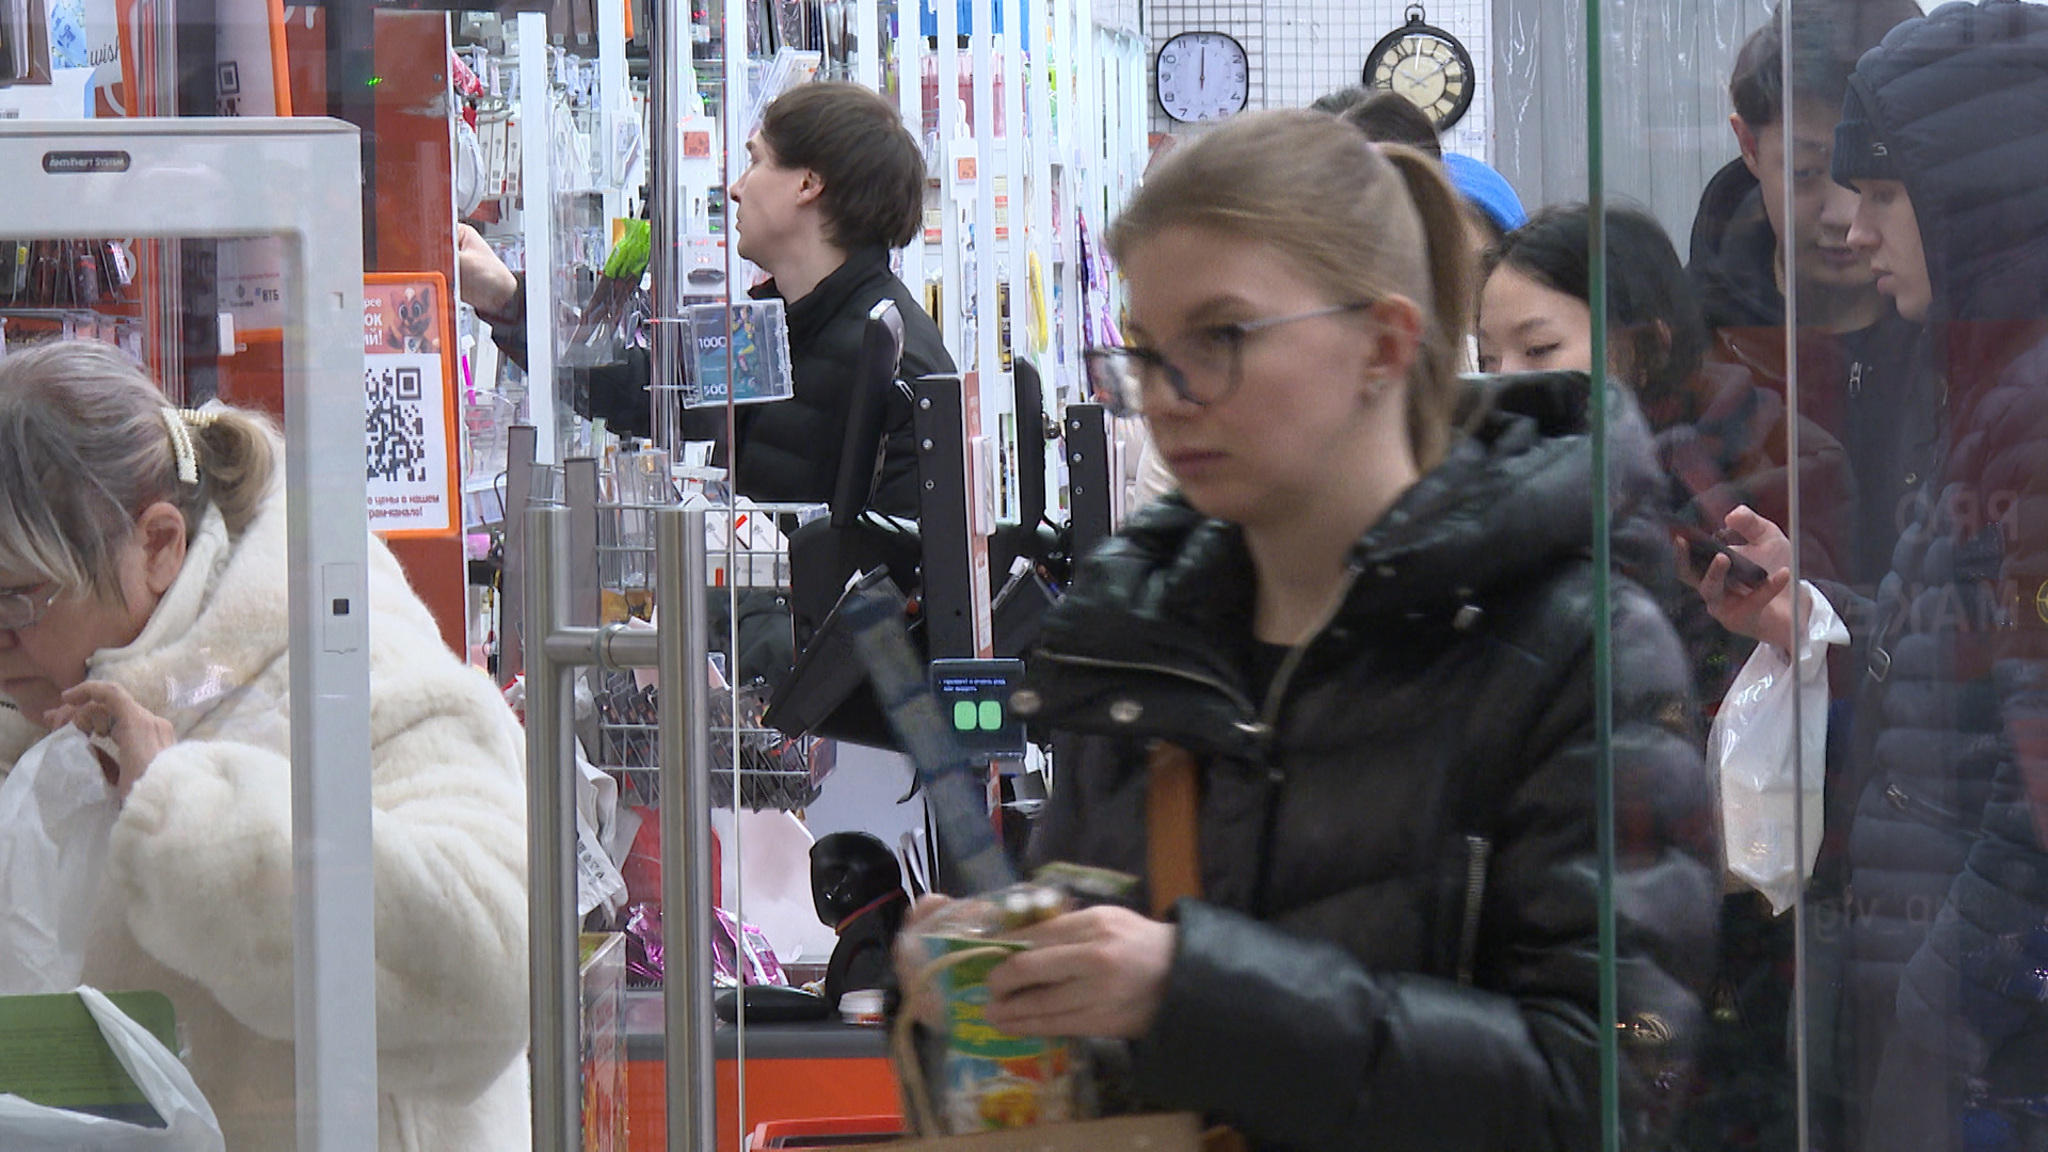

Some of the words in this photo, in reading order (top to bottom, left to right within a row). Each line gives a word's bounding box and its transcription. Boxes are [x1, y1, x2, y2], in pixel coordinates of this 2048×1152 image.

[1178, 40, 1187, 49] 11
[1196, 35, 1210, 45] 12
[1220, 40, 1225, 49] 1
[1162, 54, 1176, 65] 10
[1232, 54, 1242, 64] 2
[1230, 91, 1242, 101] 4
[1178, 107, 1189, 117] 7
[409, 494, 439, 504] нашем
